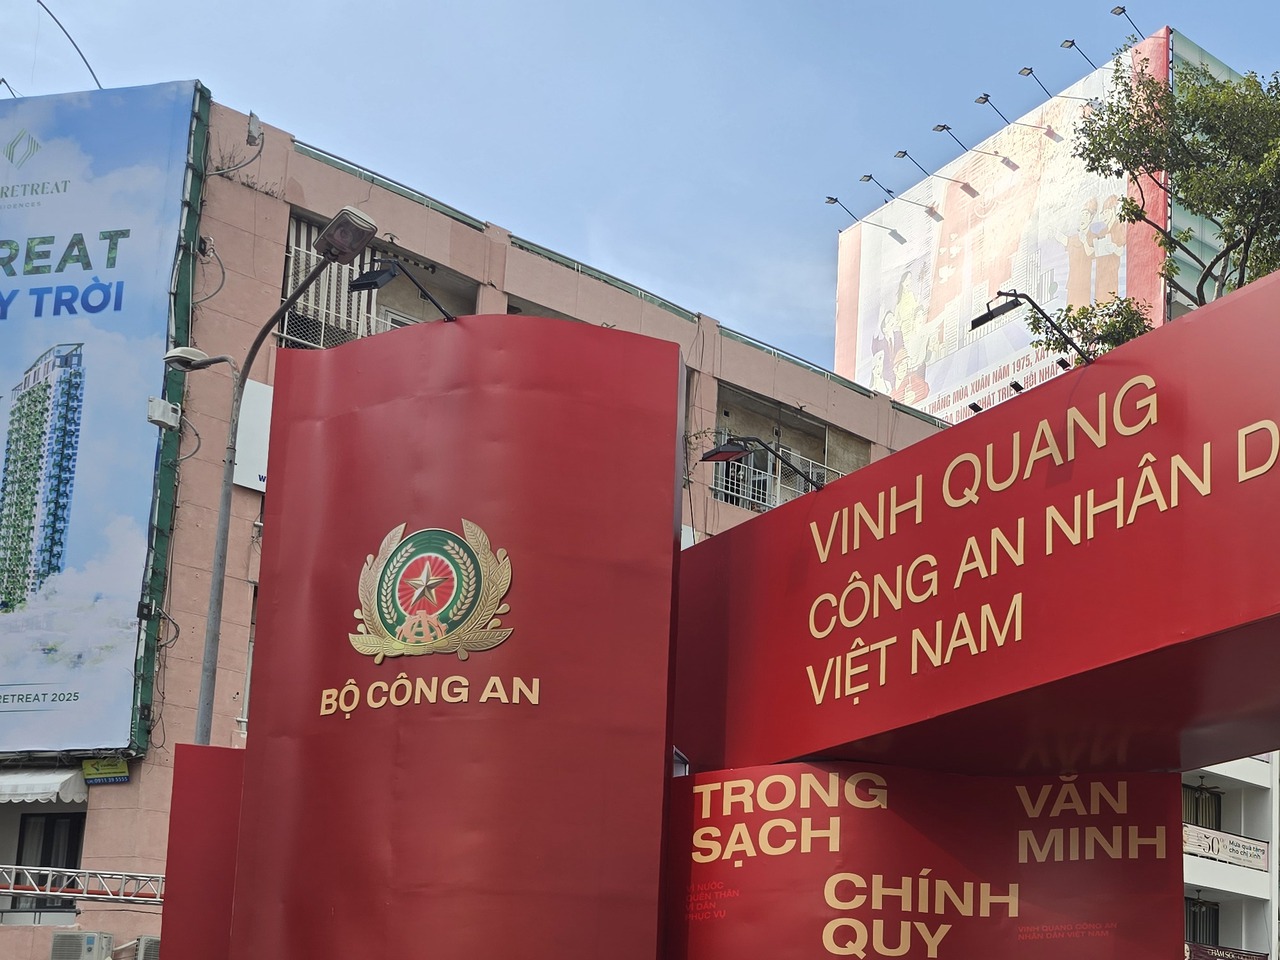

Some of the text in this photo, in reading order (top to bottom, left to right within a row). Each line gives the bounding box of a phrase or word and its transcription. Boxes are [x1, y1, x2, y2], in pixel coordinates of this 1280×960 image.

[29, 275, 125, 318] TRỜI
[953, 385, 969, 405] MÙA
[810, 374, 1160, 565] VINH QUANG
[808, 554, 939, 640] CÔNG
[953, 517, 1026, 589] AN
[1045, 441, 1212, 556] NHÂN
[806, 592, 1024, 707] VIỆT NAM
[51, 691, 80, 702] 2025
[319, 672, 540, 720] BỘ CÔNG AN
[692, 772, 888, 819] TRONG
[1015, 773, 1128, 818] VĂN
[691, 816, 841, 868] SẠCH
[1018, 825, 1167, 864] MINH
[823, 867, 1019, 918] CHÍNH
[822, 917, 953, 960] QUY
